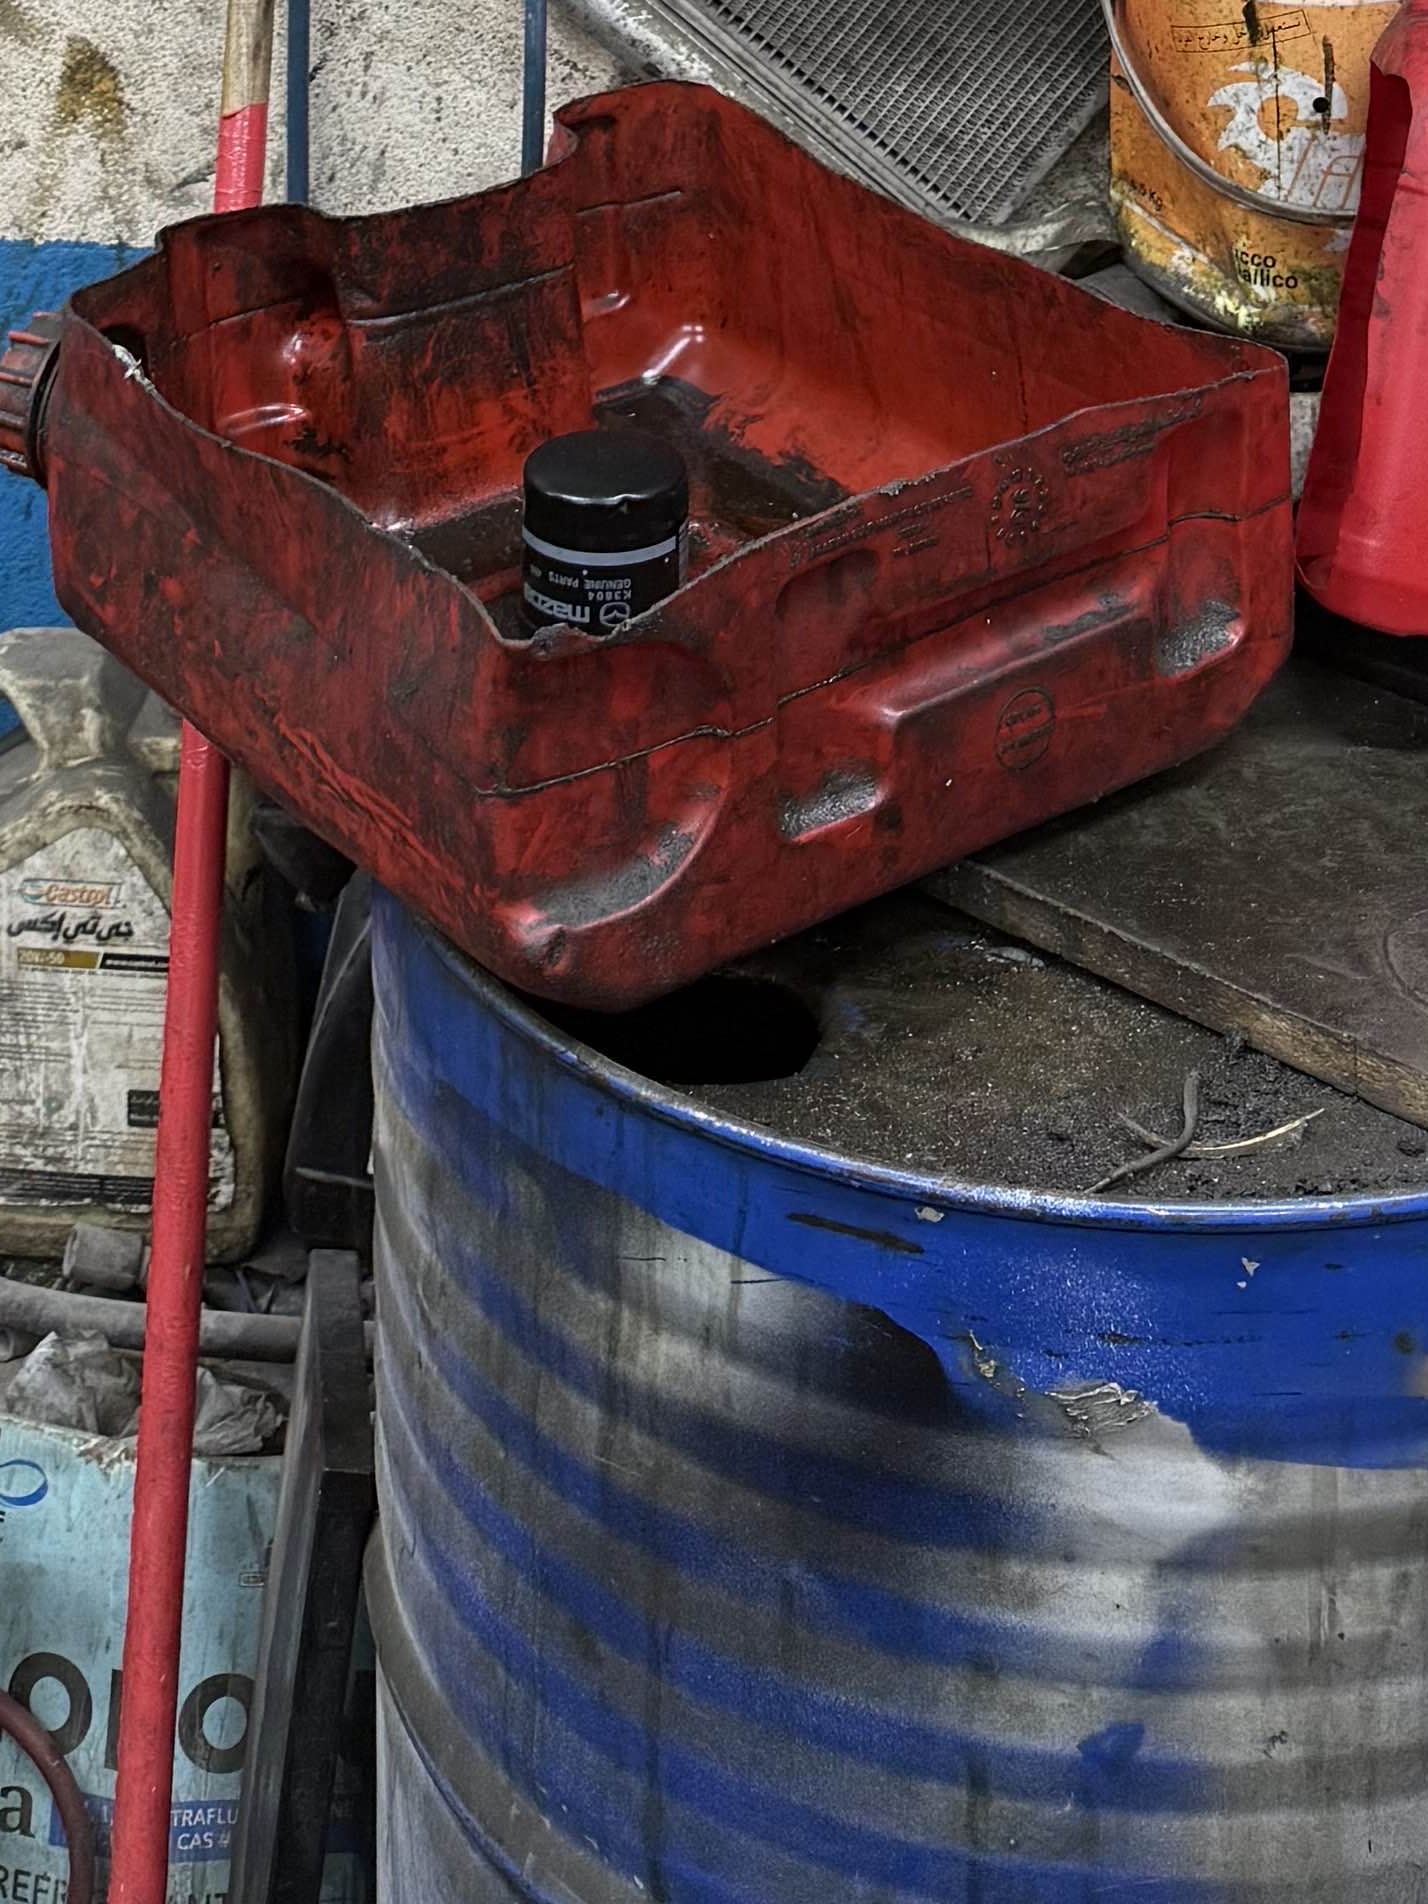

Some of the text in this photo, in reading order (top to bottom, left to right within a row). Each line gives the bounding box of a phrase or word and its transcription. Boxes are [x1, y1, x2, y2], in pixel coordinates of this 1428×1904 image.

[548, 571, 632, 590] GENUINE PARTS
[45, 884, 112, 907] Castrol
[177, 1832, 213, 1851] CAS
